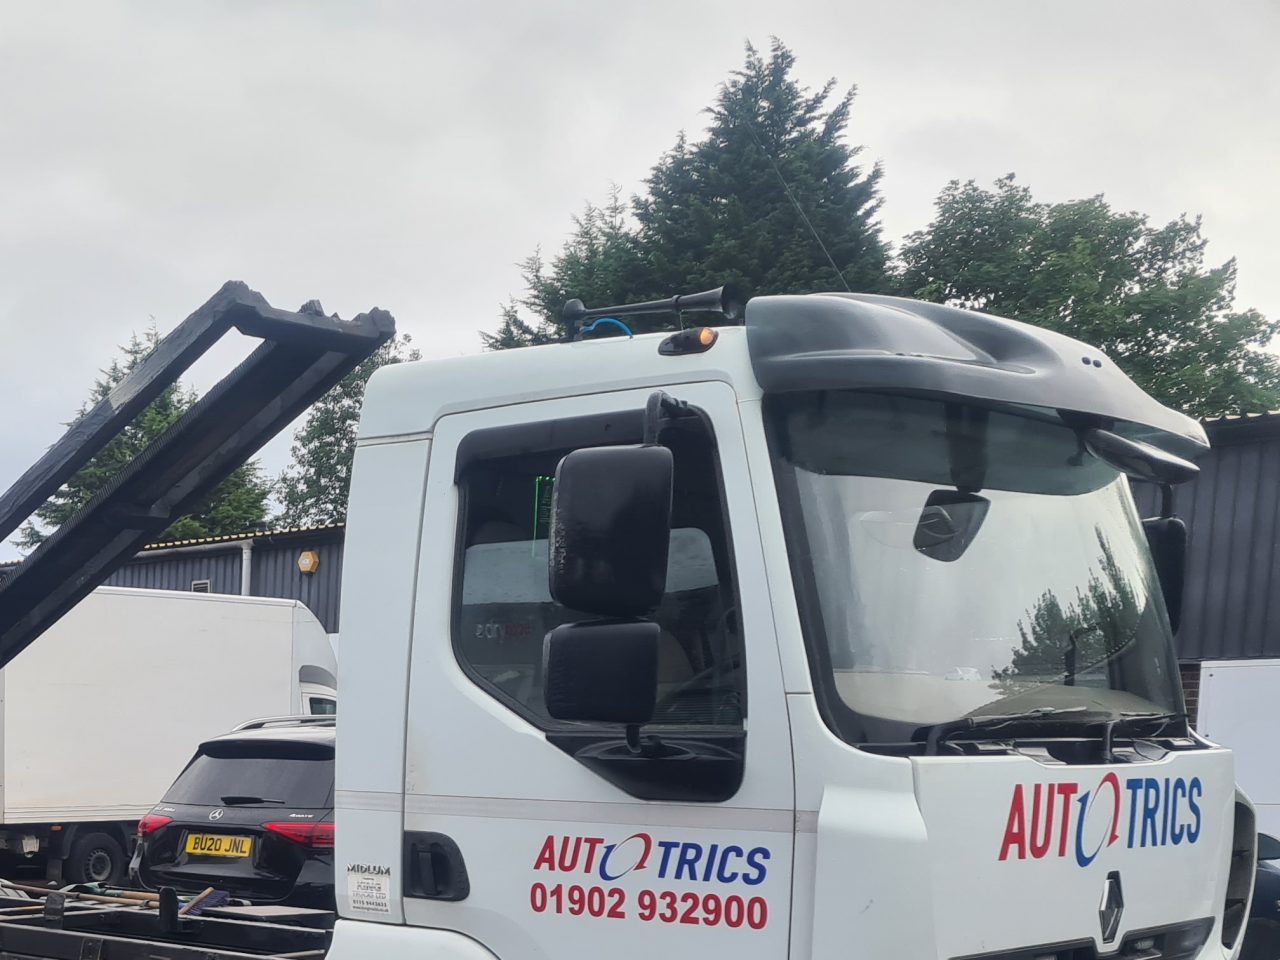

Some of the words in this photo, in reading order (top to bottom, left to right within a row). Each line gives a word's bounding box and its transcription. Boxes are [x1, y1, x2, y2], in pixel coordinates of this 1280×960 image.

[192, 836, 222, 852] BU20
[223, 840, 247, 854] JNL
[347, 863, 391, 876] MIDLUM
[530, 882, 626, 919] 01902
[638, 889, 768, 930] 932900
